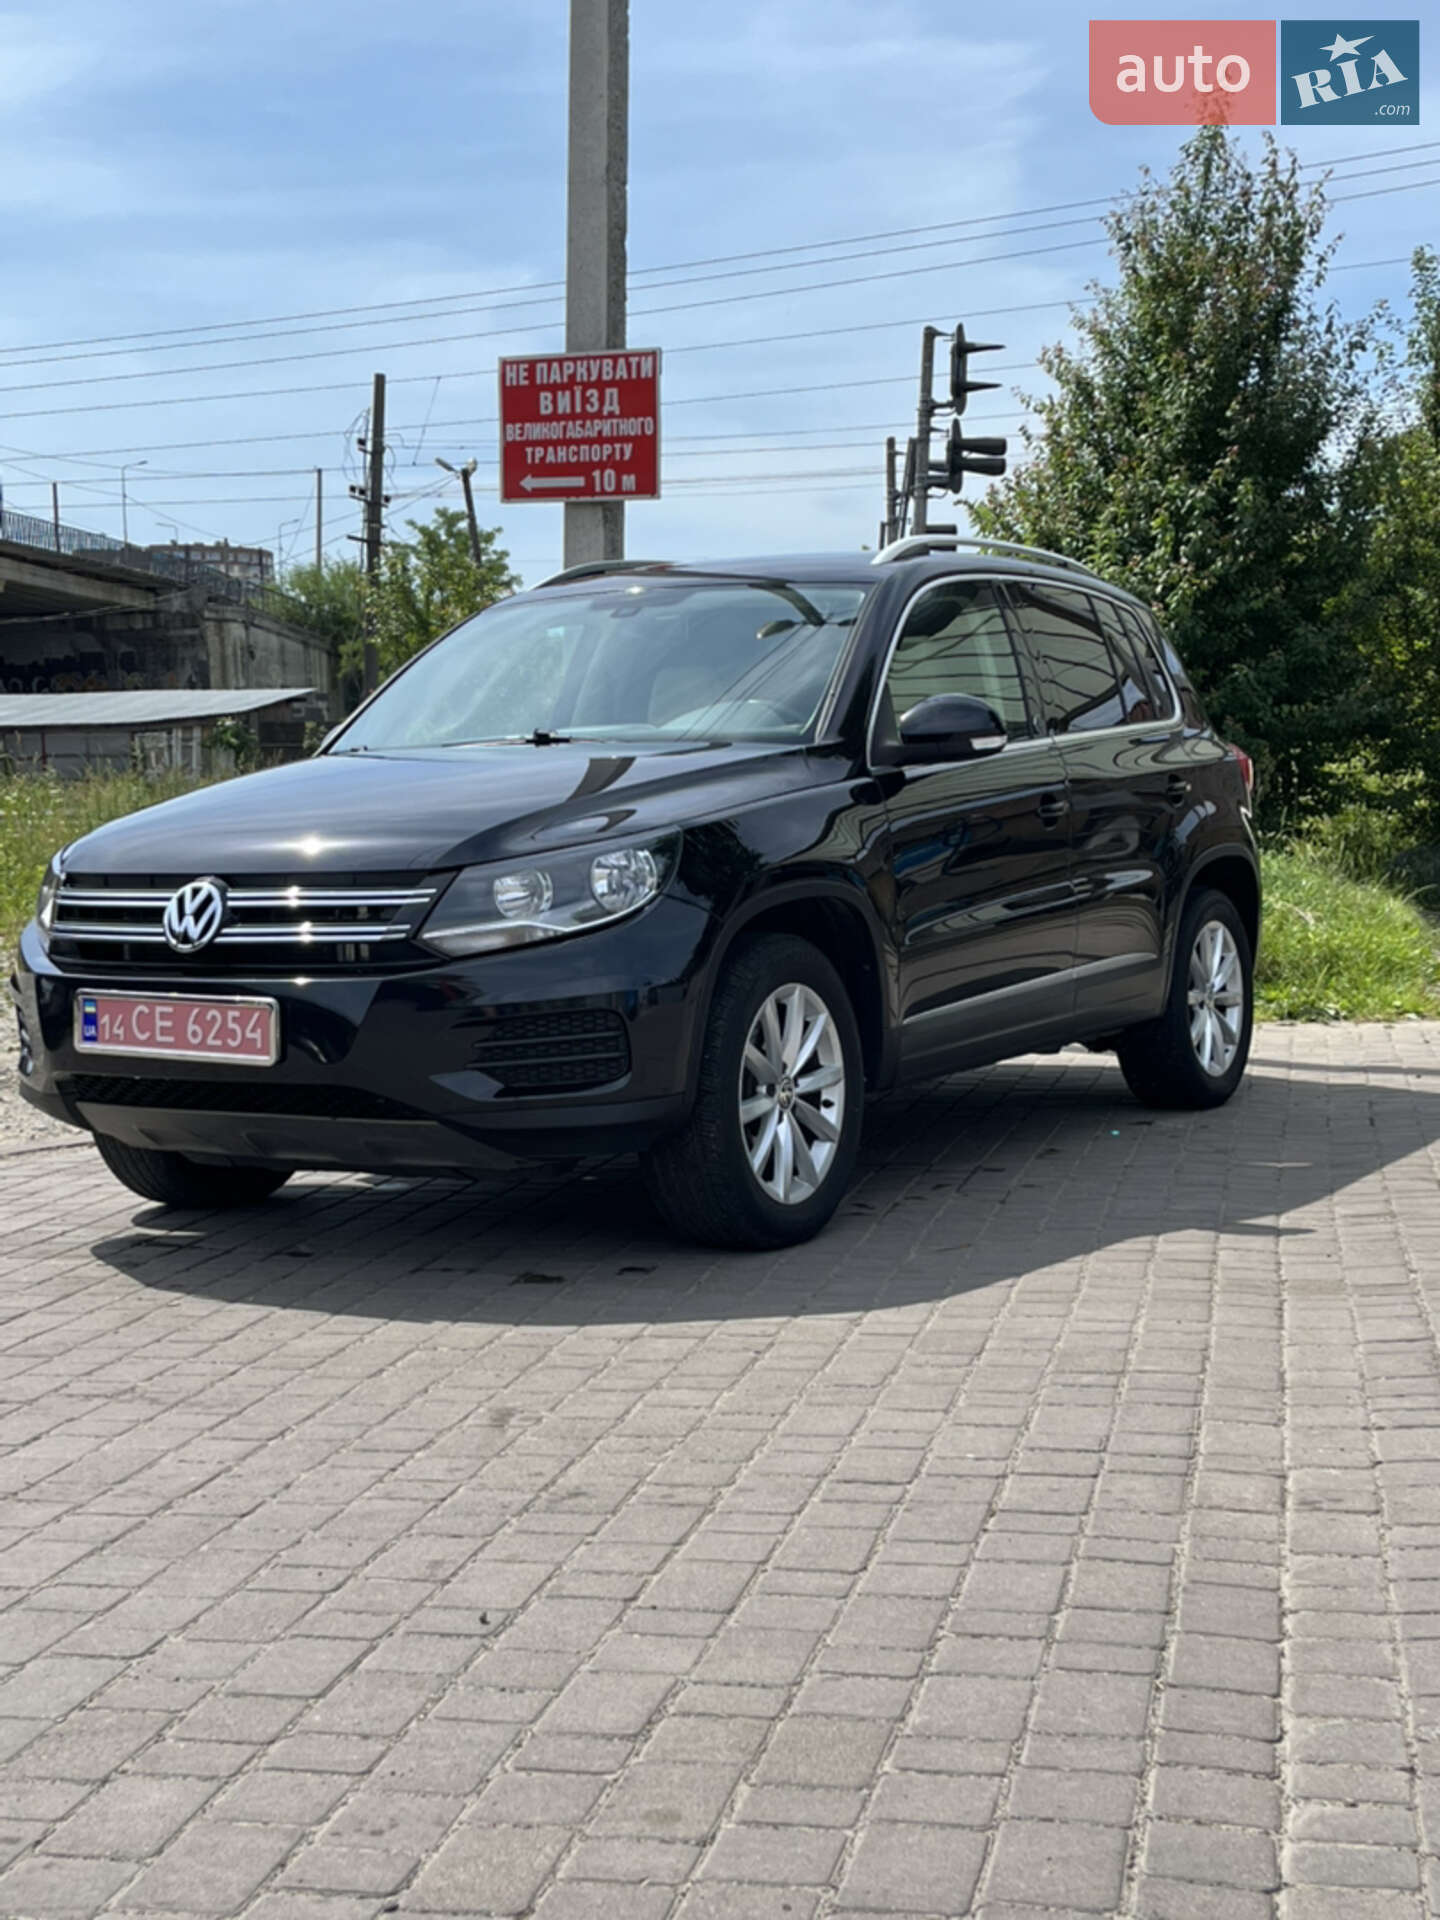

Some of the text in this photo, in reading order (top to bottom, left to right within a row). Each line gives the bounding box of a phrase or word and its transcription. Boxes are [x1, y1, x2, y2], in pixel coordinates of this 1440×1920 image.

[505, 357, 653, 386] НЕ ПАРКУВАТИ
[539, 386, 620, 416] ВИЇЗД
[525, 443, 633, 464] ТРАНСПОРТУ
[592, 469, 616, 493] 10
[187, 1007, 263, 1050] 6254
